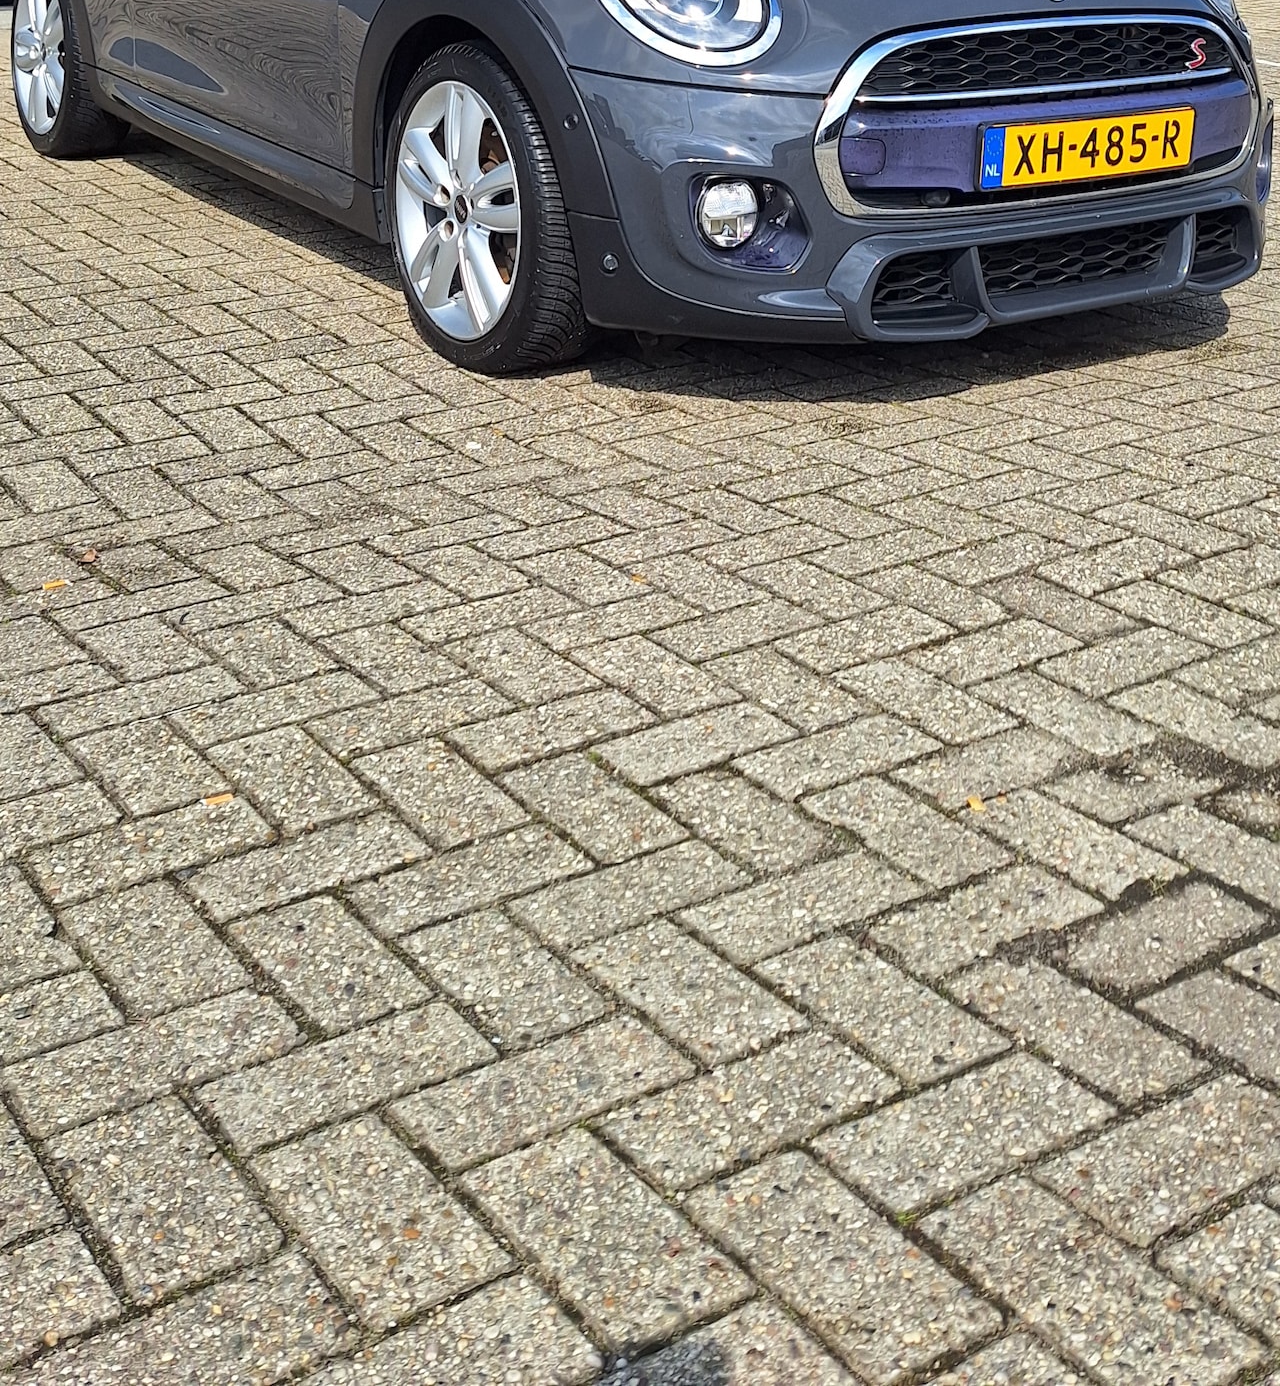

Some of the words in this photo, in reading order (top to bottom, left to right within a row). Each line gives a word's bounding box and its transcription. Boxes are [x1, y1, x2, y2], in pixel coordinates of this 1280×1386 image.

[1186, 38, 1206, 69] S
[1013, 120, 1180, 176] XH-485-R
[985, 165, 1000, 177] NL
